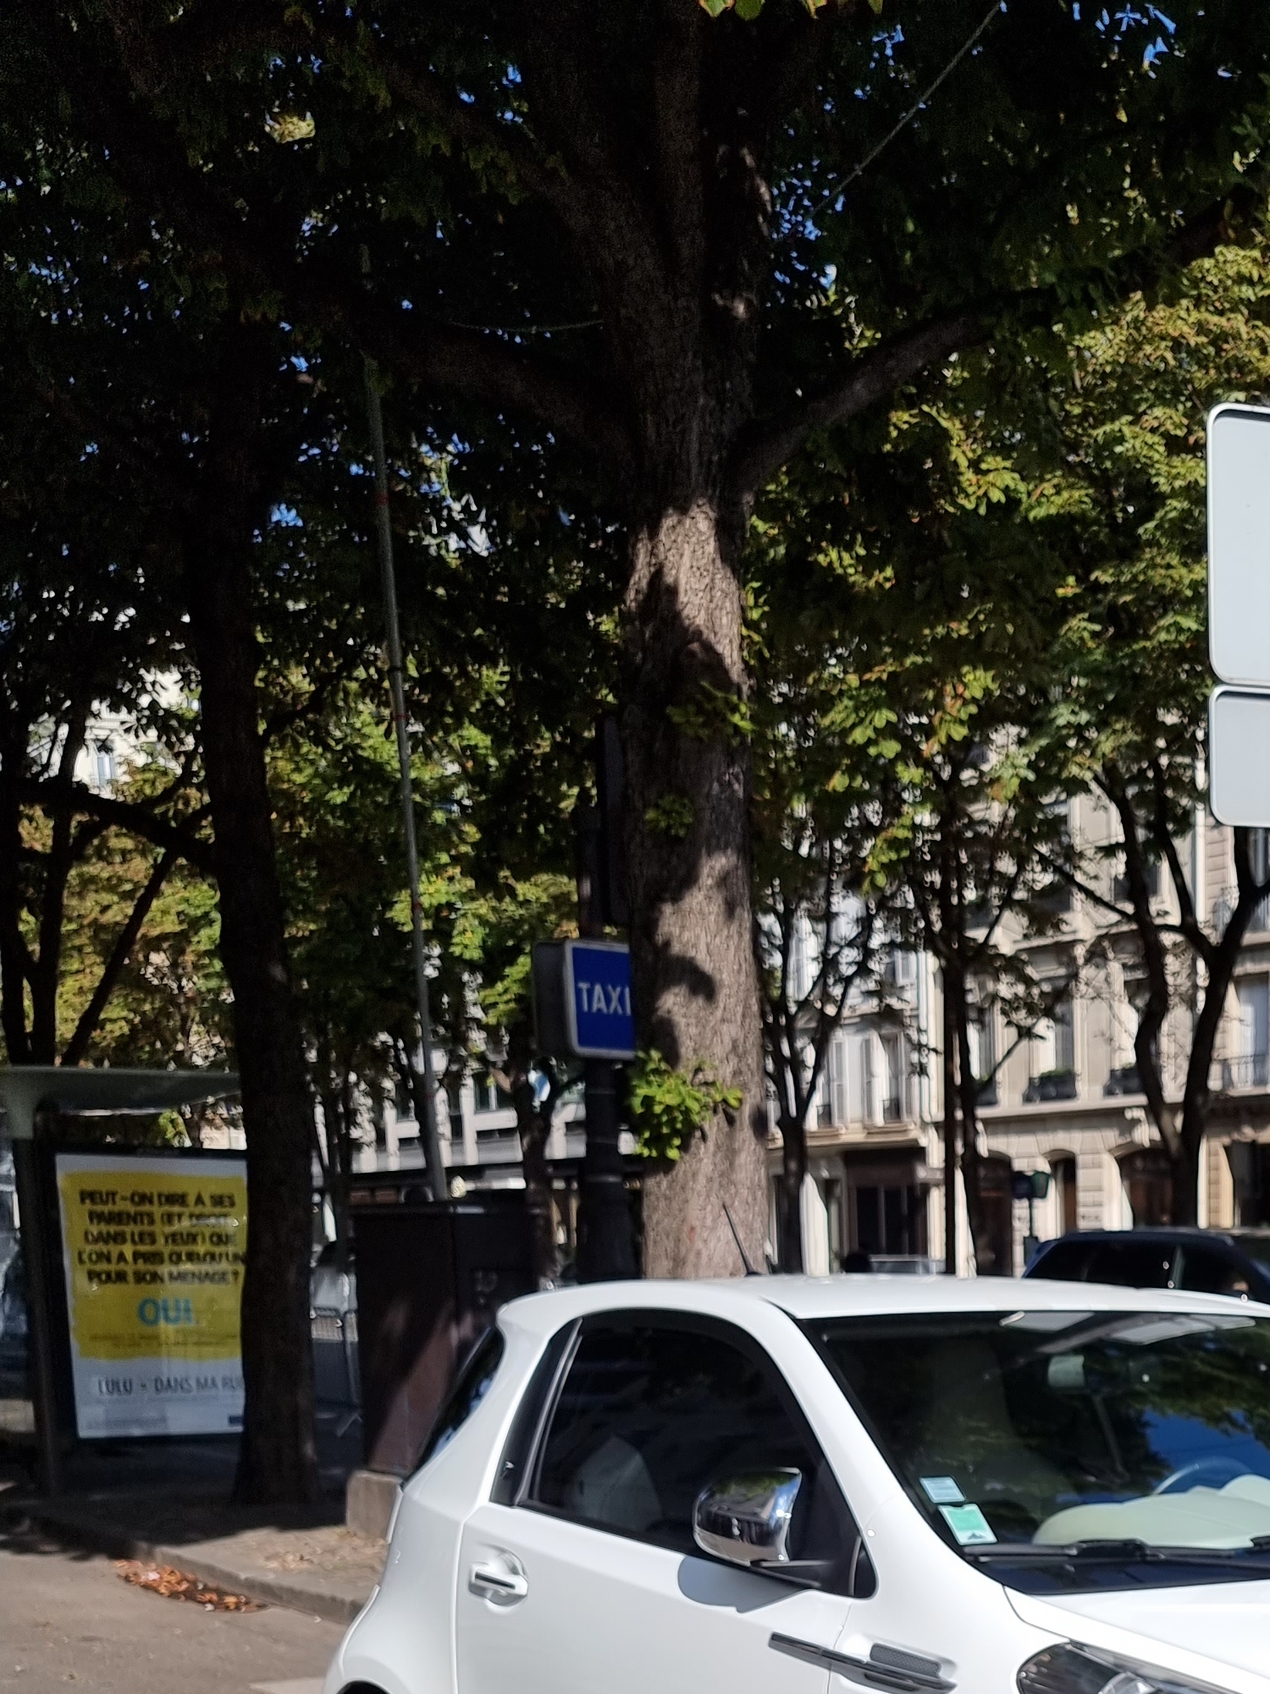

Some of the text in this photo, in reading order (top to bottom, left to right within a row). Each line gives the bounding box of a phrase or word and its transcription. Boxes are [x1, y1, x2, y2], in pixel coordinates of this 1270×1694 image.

[577, 981, 631, 1016] TAXI
[157, 1192, 188, 1207] DIRE
[210, 1193, 235, 1208] SES
[88, 1210, 155, 1226] PARENTS
[84, 1231, 127, 1246] DANS
[131, 1231, 156, 1246] LES
[116, 1251, 129, 1265] A
[132, 1250, 164, 1265] PRIS
[87, 1269, 128, 1285] POUR
[132, 1270, 164, 1284] SON
[98, 1377, 133, 1396] LULU
[154, 1376, 193, 1395] DANS
[195, 1375, 218, 1391] MA
